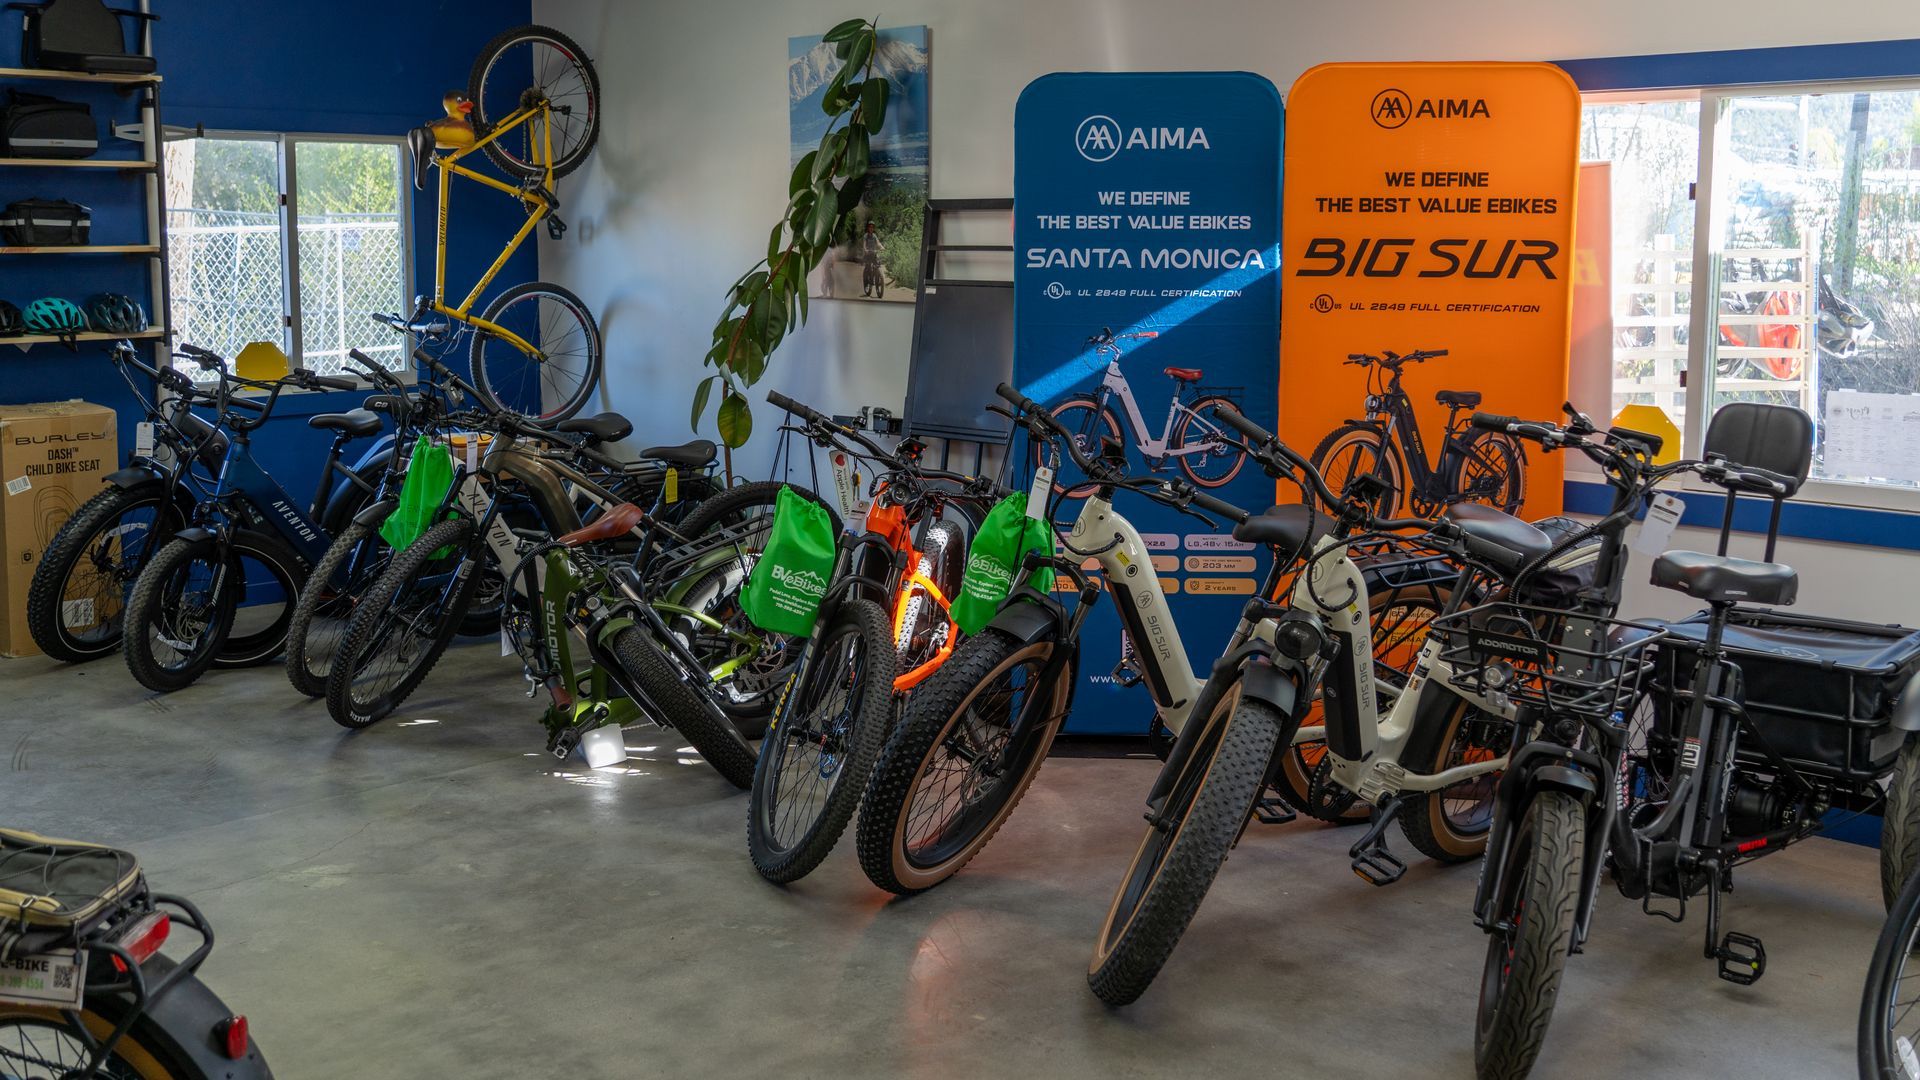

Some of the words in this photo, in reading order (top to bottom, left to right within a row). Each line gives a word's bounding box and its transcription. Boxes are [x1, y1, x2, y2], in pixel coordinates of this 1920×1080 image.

[1415, 99, 1491, 119] AIMA
[1126, 127, 1211, 150] AIMA
[1385, 171, 1415, 187] WE
[1421, 171, 1489, 188] DEFINE
[1098, 191, 1126, 206] WE
[1130, 191, 1191, 206] DEFINE
[1315, 197, 1353, 213] THE
[1358, 197, 1411, 213] BEST
[1417, 198, 1481, 214] VALUE
[1487, 198, 1557, 214] EBIKES
[1037, 215, 1071, 230] THE
[1075, 215, 1122, 230] BEST
[1127, 215, 1185, 230] VALUE
[1189, 215, 1252, 230] EBIKES
[1026, 248, 1132, 269] SANTA
[1140, 248, 1266, 270] MONICA
[1295, 237, 1416, 278] BIG
[1417, 238, 1560, 280] SUR
[1077, 289, 1091, 297] UL
[1095, 289, 1127, 297] 2849
[1129, 289, 1157, 297] FULL
[1161, 289, 1242, 298] CERTIFICATION
[1349, 303, 1365, 311] UL
[1370, 303, 1406, 312] 2849
[1409, 303, 1441, 312] FULL
[1446, 303, 1541, 313] CERTIFICATION
[15, 431, 106, 446] BURLEY
[25, 463, 54, 477] CHILD
[55, 461, 77, 474] BIKE
[78, 459, 101, 472] SEAT
[271, 500, 318, 542] AVENTON
[466, 492, 513, 548] AVETON
[1155, 636, 1171, 661] SUR
[1477, 637, 1539, 656] ADDMOTOR
[770, 672, 797, 730] KENDA
[1361, 684, 1370, 711] SUR
